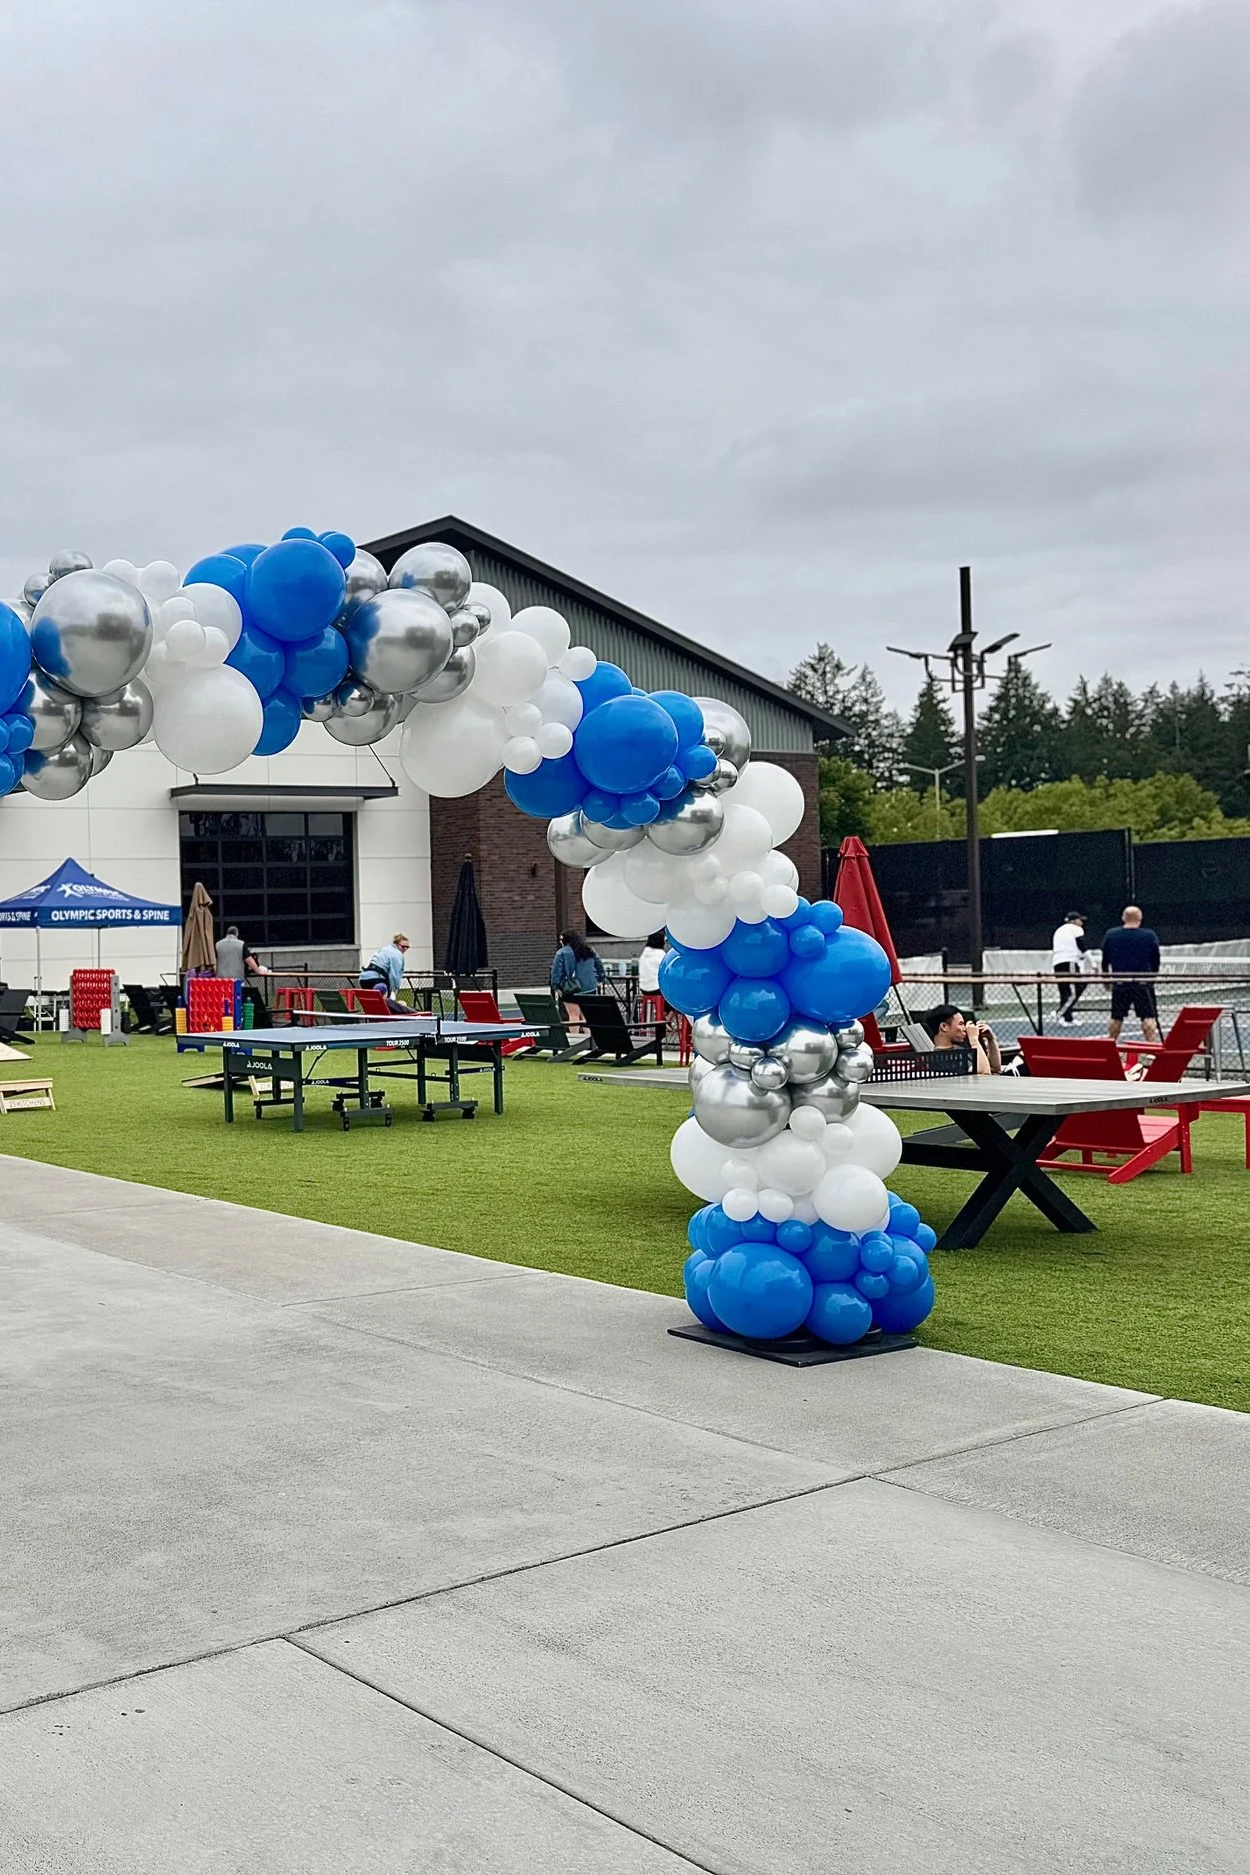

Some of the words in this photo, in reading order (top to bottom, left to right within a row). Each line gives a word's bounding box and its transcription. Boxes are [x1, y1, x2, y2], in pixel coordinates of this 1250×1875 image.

[51, 909, 96, 921] OLYMPIC
[96, 908, 132, 920] SPORTS
[134, 909, 141, 920] &
[142, 909, 170, 921] SPINE
[251, 1061, 273, 1070] JOOLA
